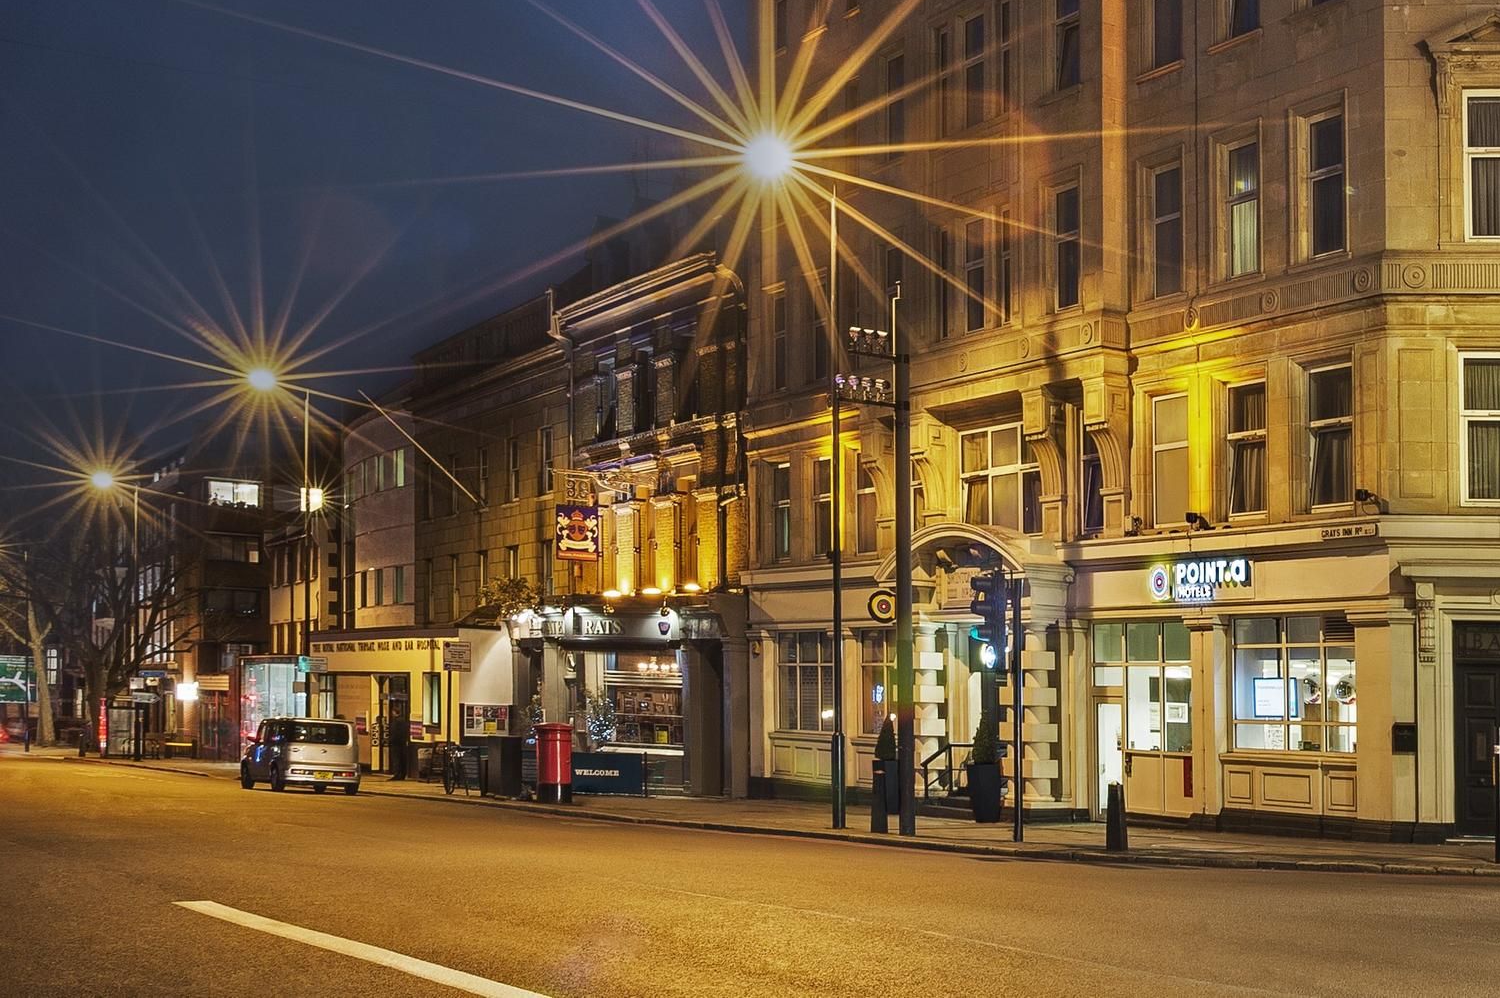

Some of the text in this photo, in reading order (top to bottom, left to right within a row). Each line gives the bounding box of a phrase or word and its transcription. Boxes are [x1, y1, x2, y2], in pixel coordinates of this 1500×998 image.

[1321, 529, 1340, 538] GRAYS
[1342, 527, 1353, 536] INN
[1177, 583, 1213, 598] HOTELS
[584, 619, 622, 635] RATS
[574, 769, 620, 777] WELCOME
